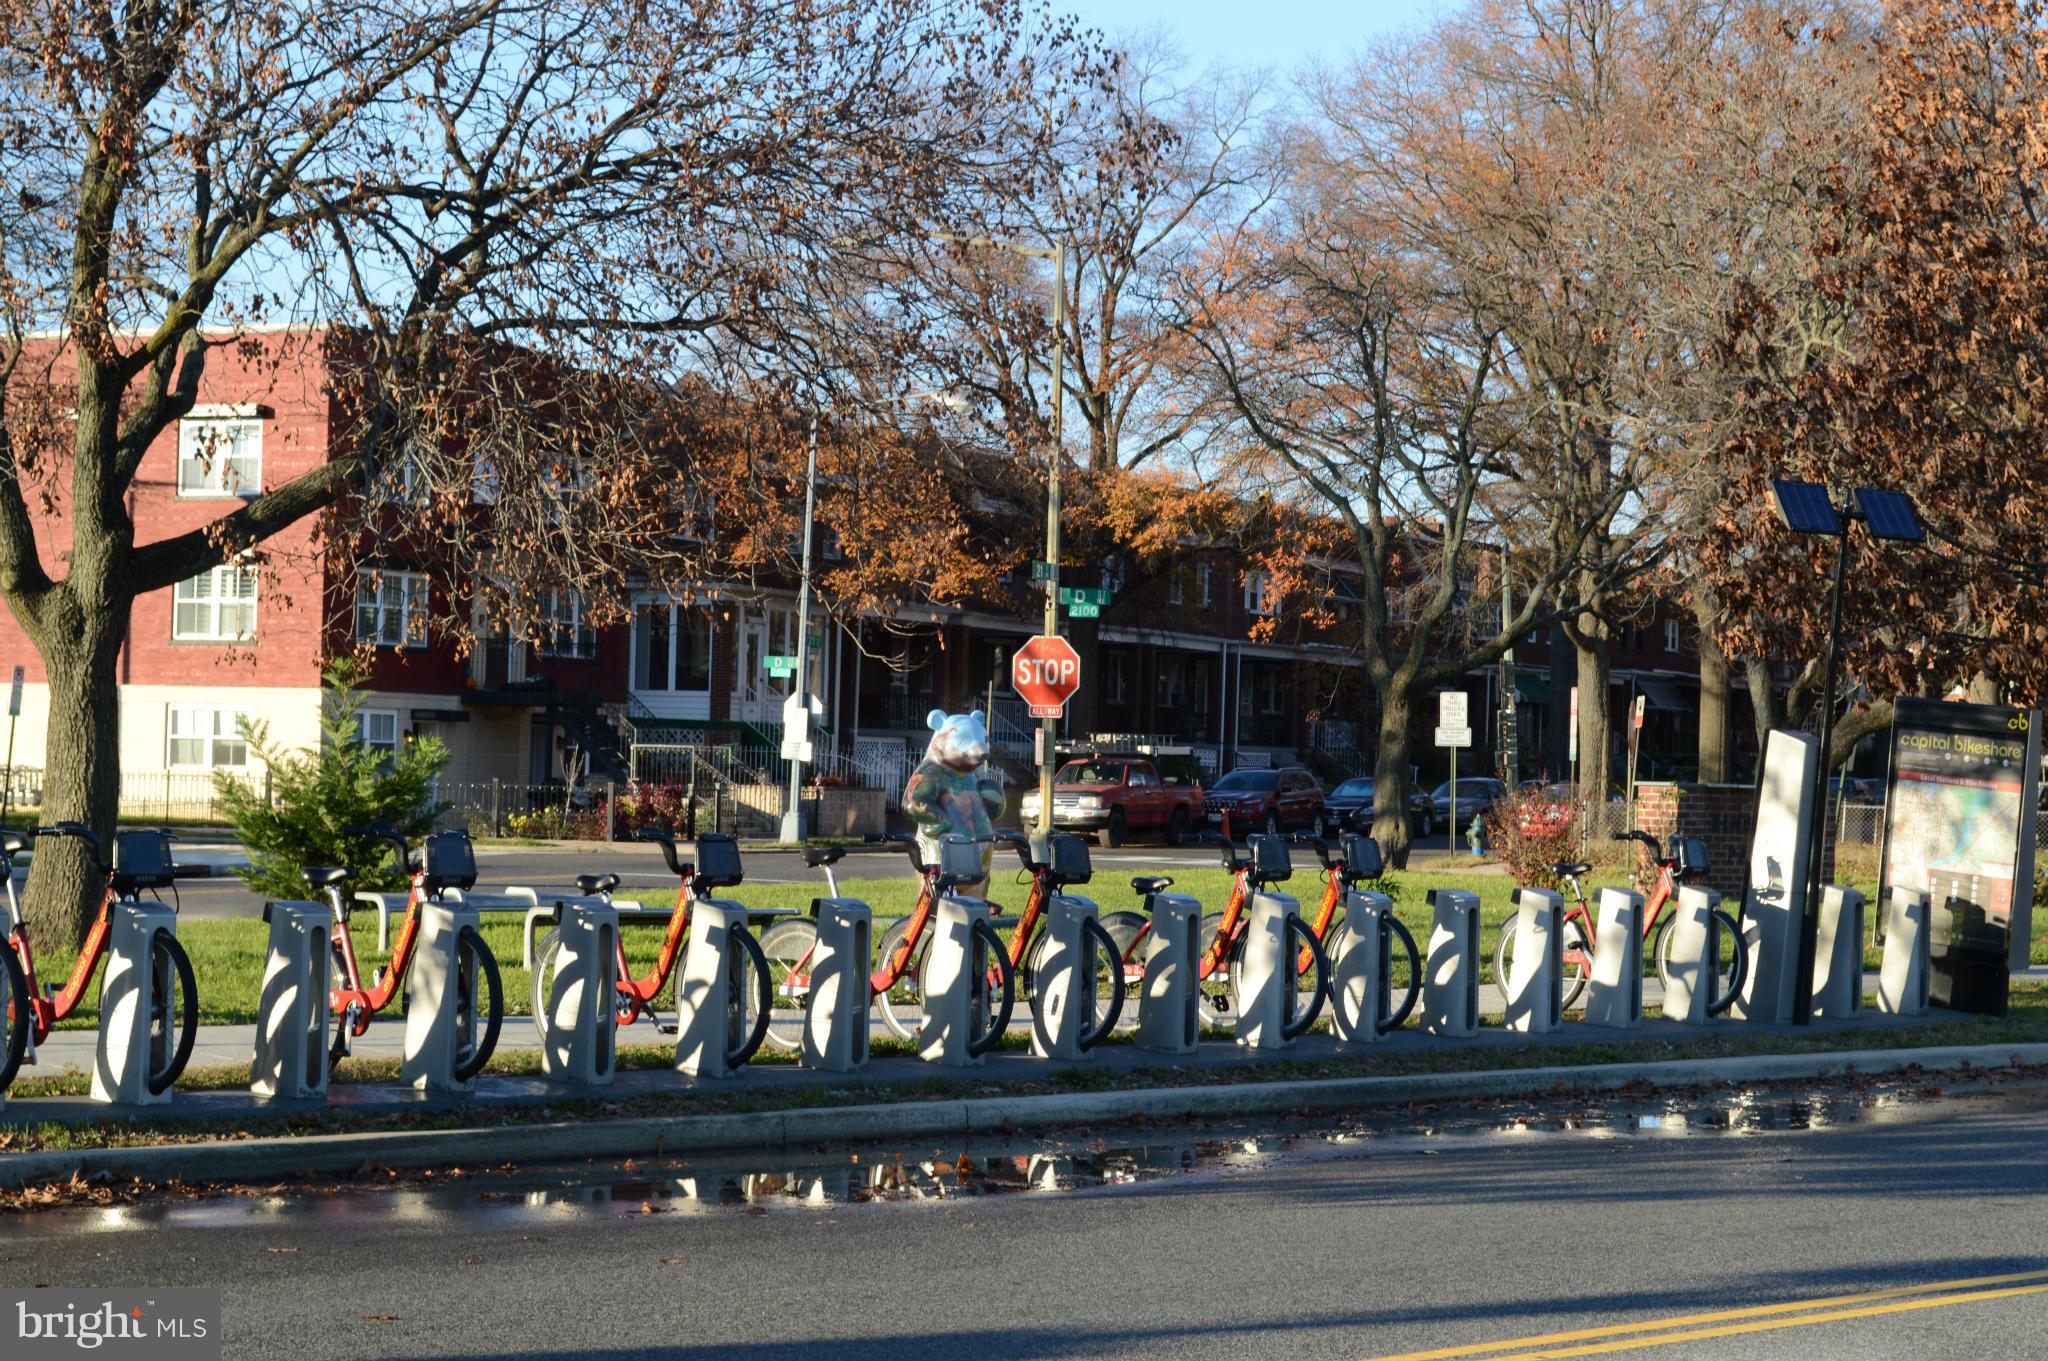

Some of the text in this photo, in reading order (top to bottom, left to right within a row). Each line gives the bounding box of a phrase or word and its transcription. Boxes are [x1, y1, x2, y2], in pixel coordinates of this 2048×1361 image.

[1074, 590, 1086, 604] D
[1071, 606, 1098, 616] 2100
[774, 657, 783, 667] D
[1017, 658, 1075, 686] STOP
[1032, 707, 1044, 715] ALL
[1900, 734, 1950, 751] capital
[1954, 734, 2022, 758] bikeshare
[1920, 774, 1936, 782] Local
[1936, 775, 1959, 785] Stations
[383, 953, 399, 992] capal
